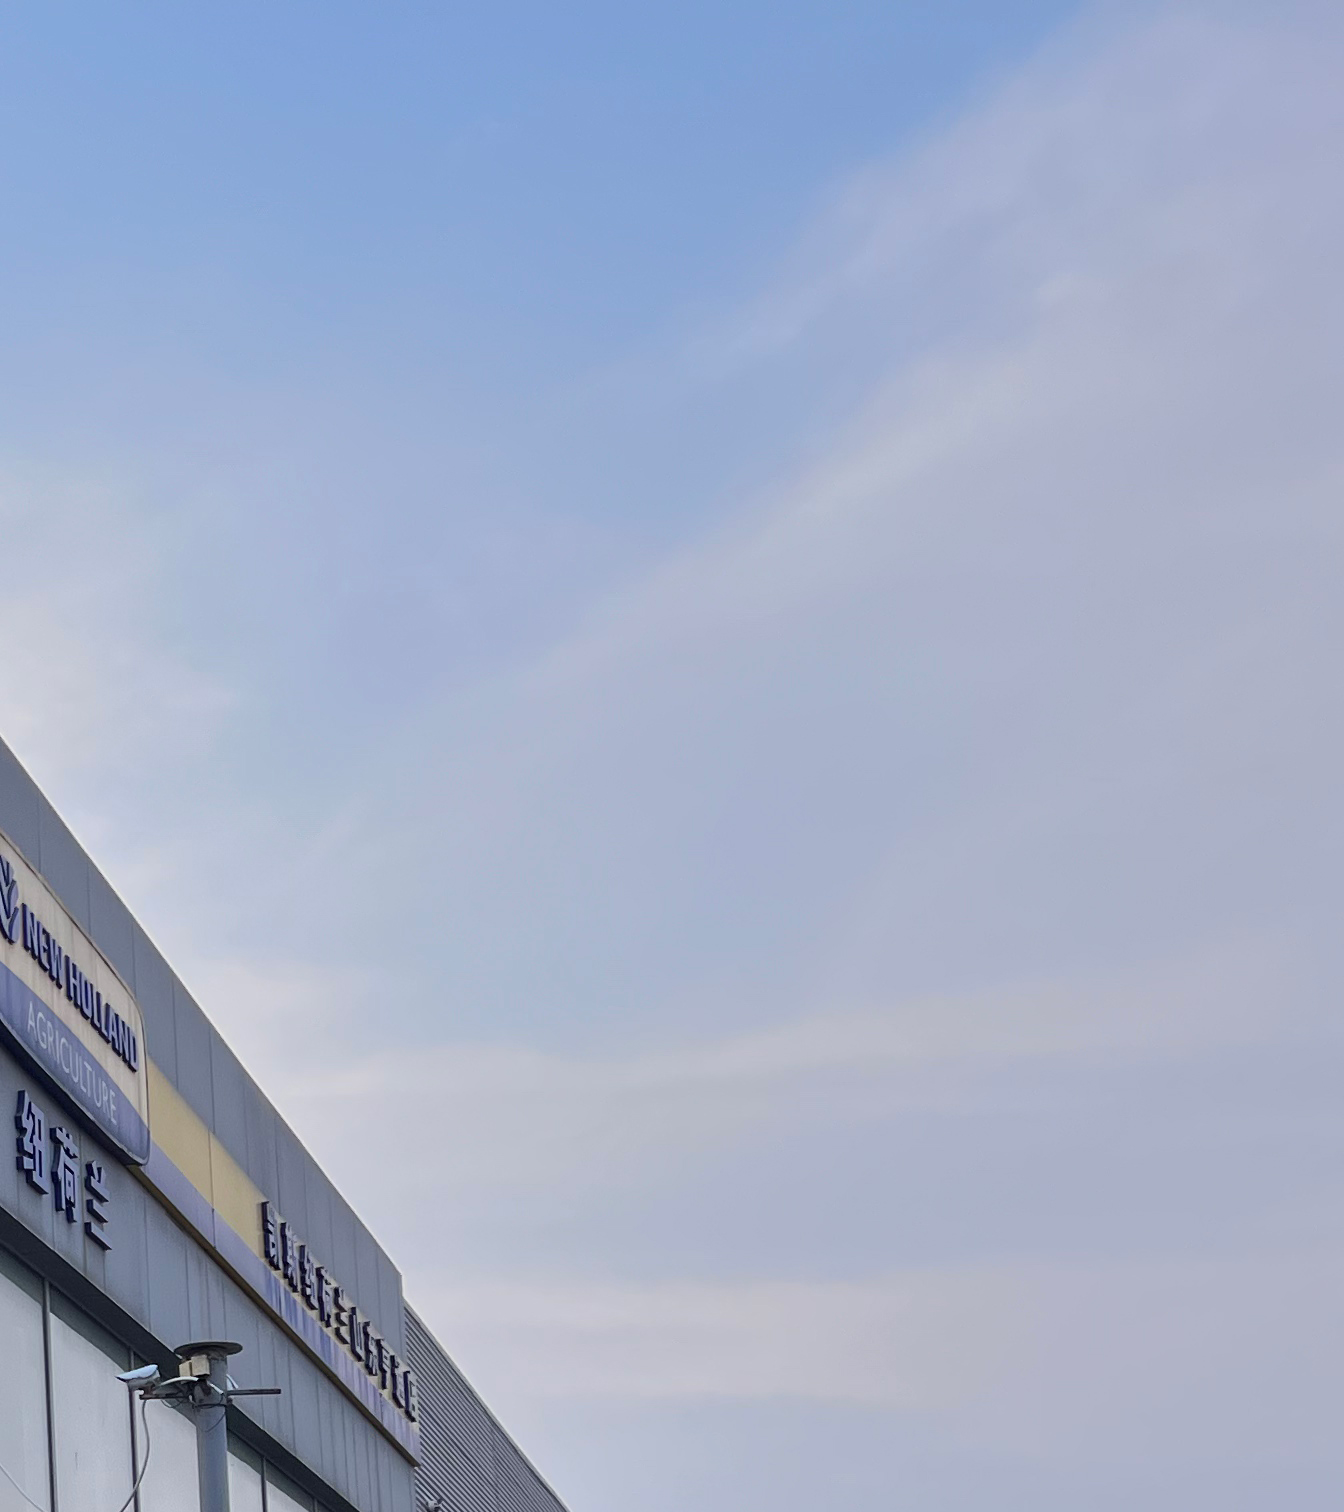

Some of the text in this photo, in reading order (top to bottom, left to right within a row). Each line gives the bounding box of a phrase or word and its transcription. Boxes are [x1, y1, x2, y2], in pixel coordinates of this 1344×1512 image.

[22, 902, 140, 1073] NEW HOLLAND
[27, 1000, 118, 1125] AGRICULTURE
[14, 1089, 113, 1251] 纽荷兰
